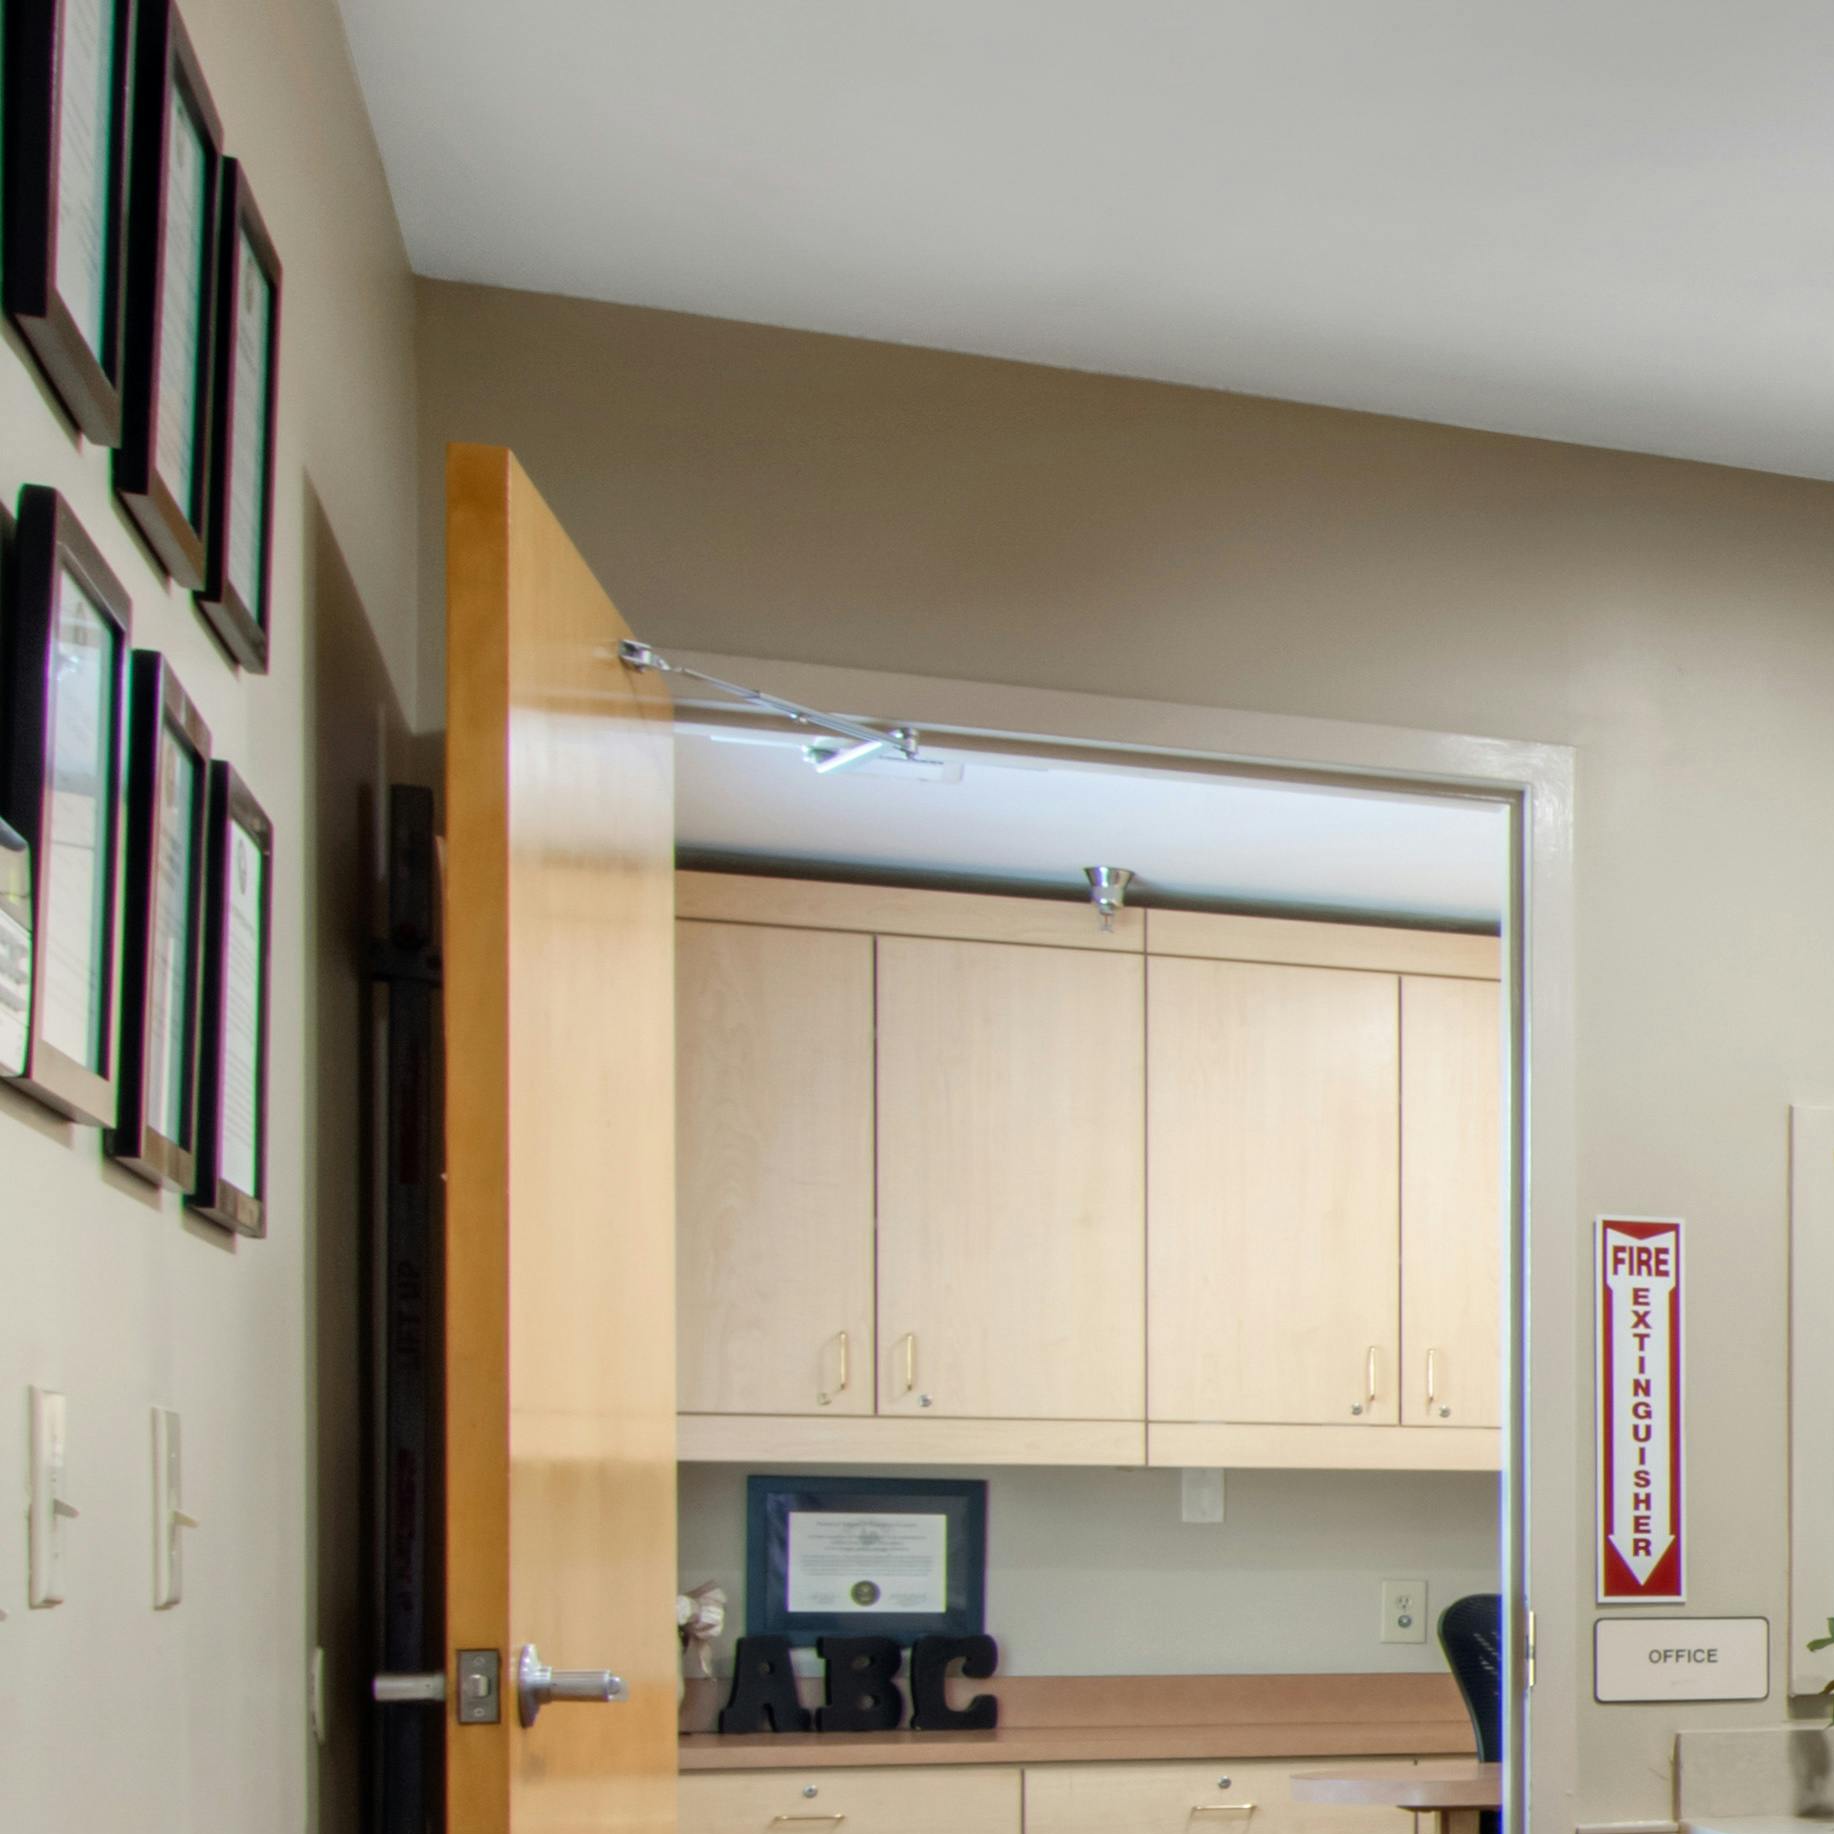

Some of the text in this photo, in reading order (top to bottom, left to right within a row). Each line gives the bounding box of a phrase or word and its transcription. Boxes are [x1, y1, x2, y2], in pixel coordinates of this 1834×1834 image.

[1612, 1246, 1670, 1277] FIRE
[1631, 1287, 1652, 1558] EXTINGUISHER
[719, 1633, 999, 1733] ABC
[1648, 1649, 1718, 1665] OFFICE
